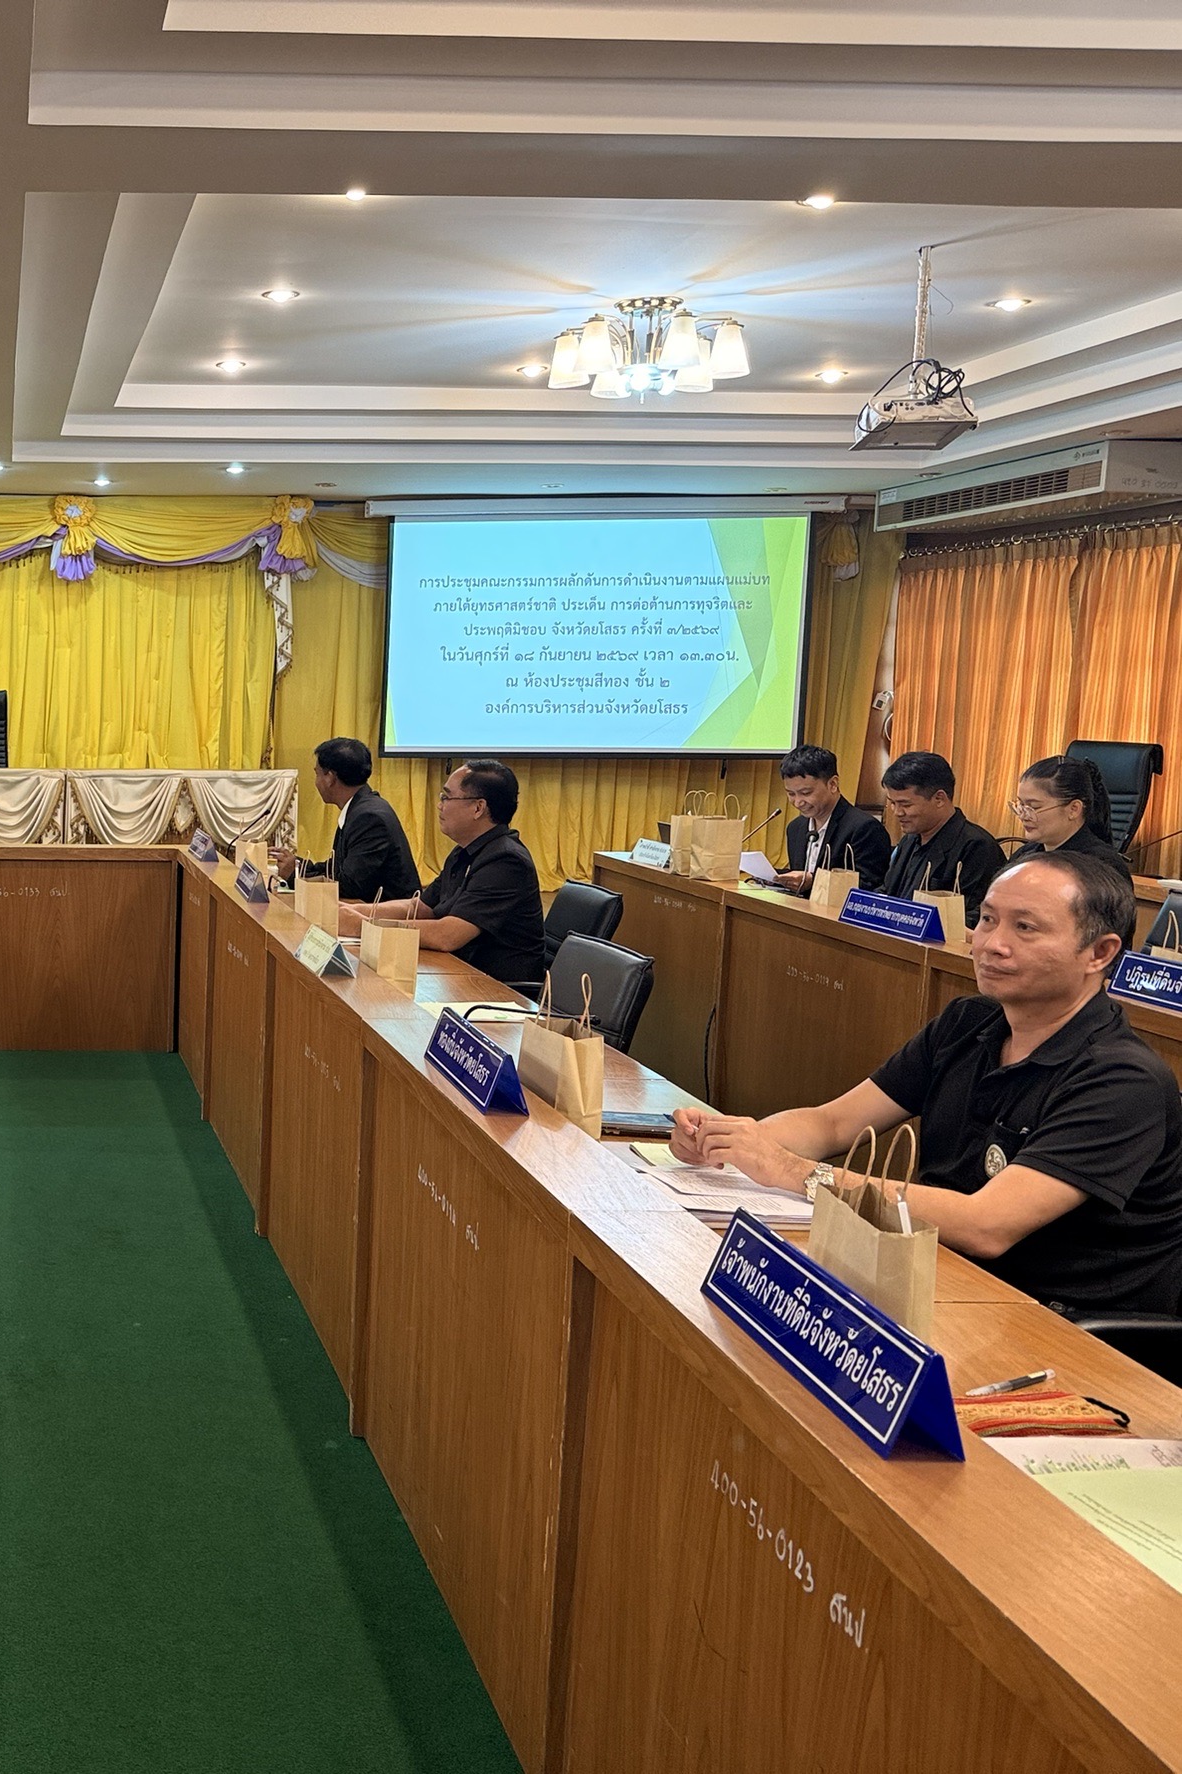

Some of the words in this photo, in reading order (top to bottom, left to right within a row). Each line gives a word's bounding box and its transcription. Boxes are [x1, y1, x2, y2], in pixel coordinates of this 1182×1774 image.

[419, 572, 770, 592] การประชุมคณะกรรมการผลักดันการดำเนินงานตามแผนแม่บท
[433, 596, 556, 616] ภายใต้ยุทธศาสตร์ชาติ
[561, 595, 606, 612] ประเด็น
[610, 595, 753, 614] การต่อต้านการทุจริตและ
[463, 621, 547, 638] ประพฤติมิชอบ
[551, 621, 626, 636] จังหวัดยโสธร
[631, 616, 663, 636] ครั้งที่
[439, 643, 509, 666] ในวันศุกร์ที่
[514, 650, 535, 662] ๑๘
[539, 645, 592, 661] กันยายน
[643, 650, 674, 661] เวลา
[505, 676, 519, 688] ณ
[523, 672, 629, 692] ห้องประชุมสีทอง
[634, 667, 654, 688] ชั้น
[659, 677, 670, 688] ๒
[485, 698, 688, 714] องค์การบริหารส่วนจังหวัดยโสธร
[721, 1237, 903, 1411] เจ้าพนักงานที่ดินจังหวัดยโสธร
